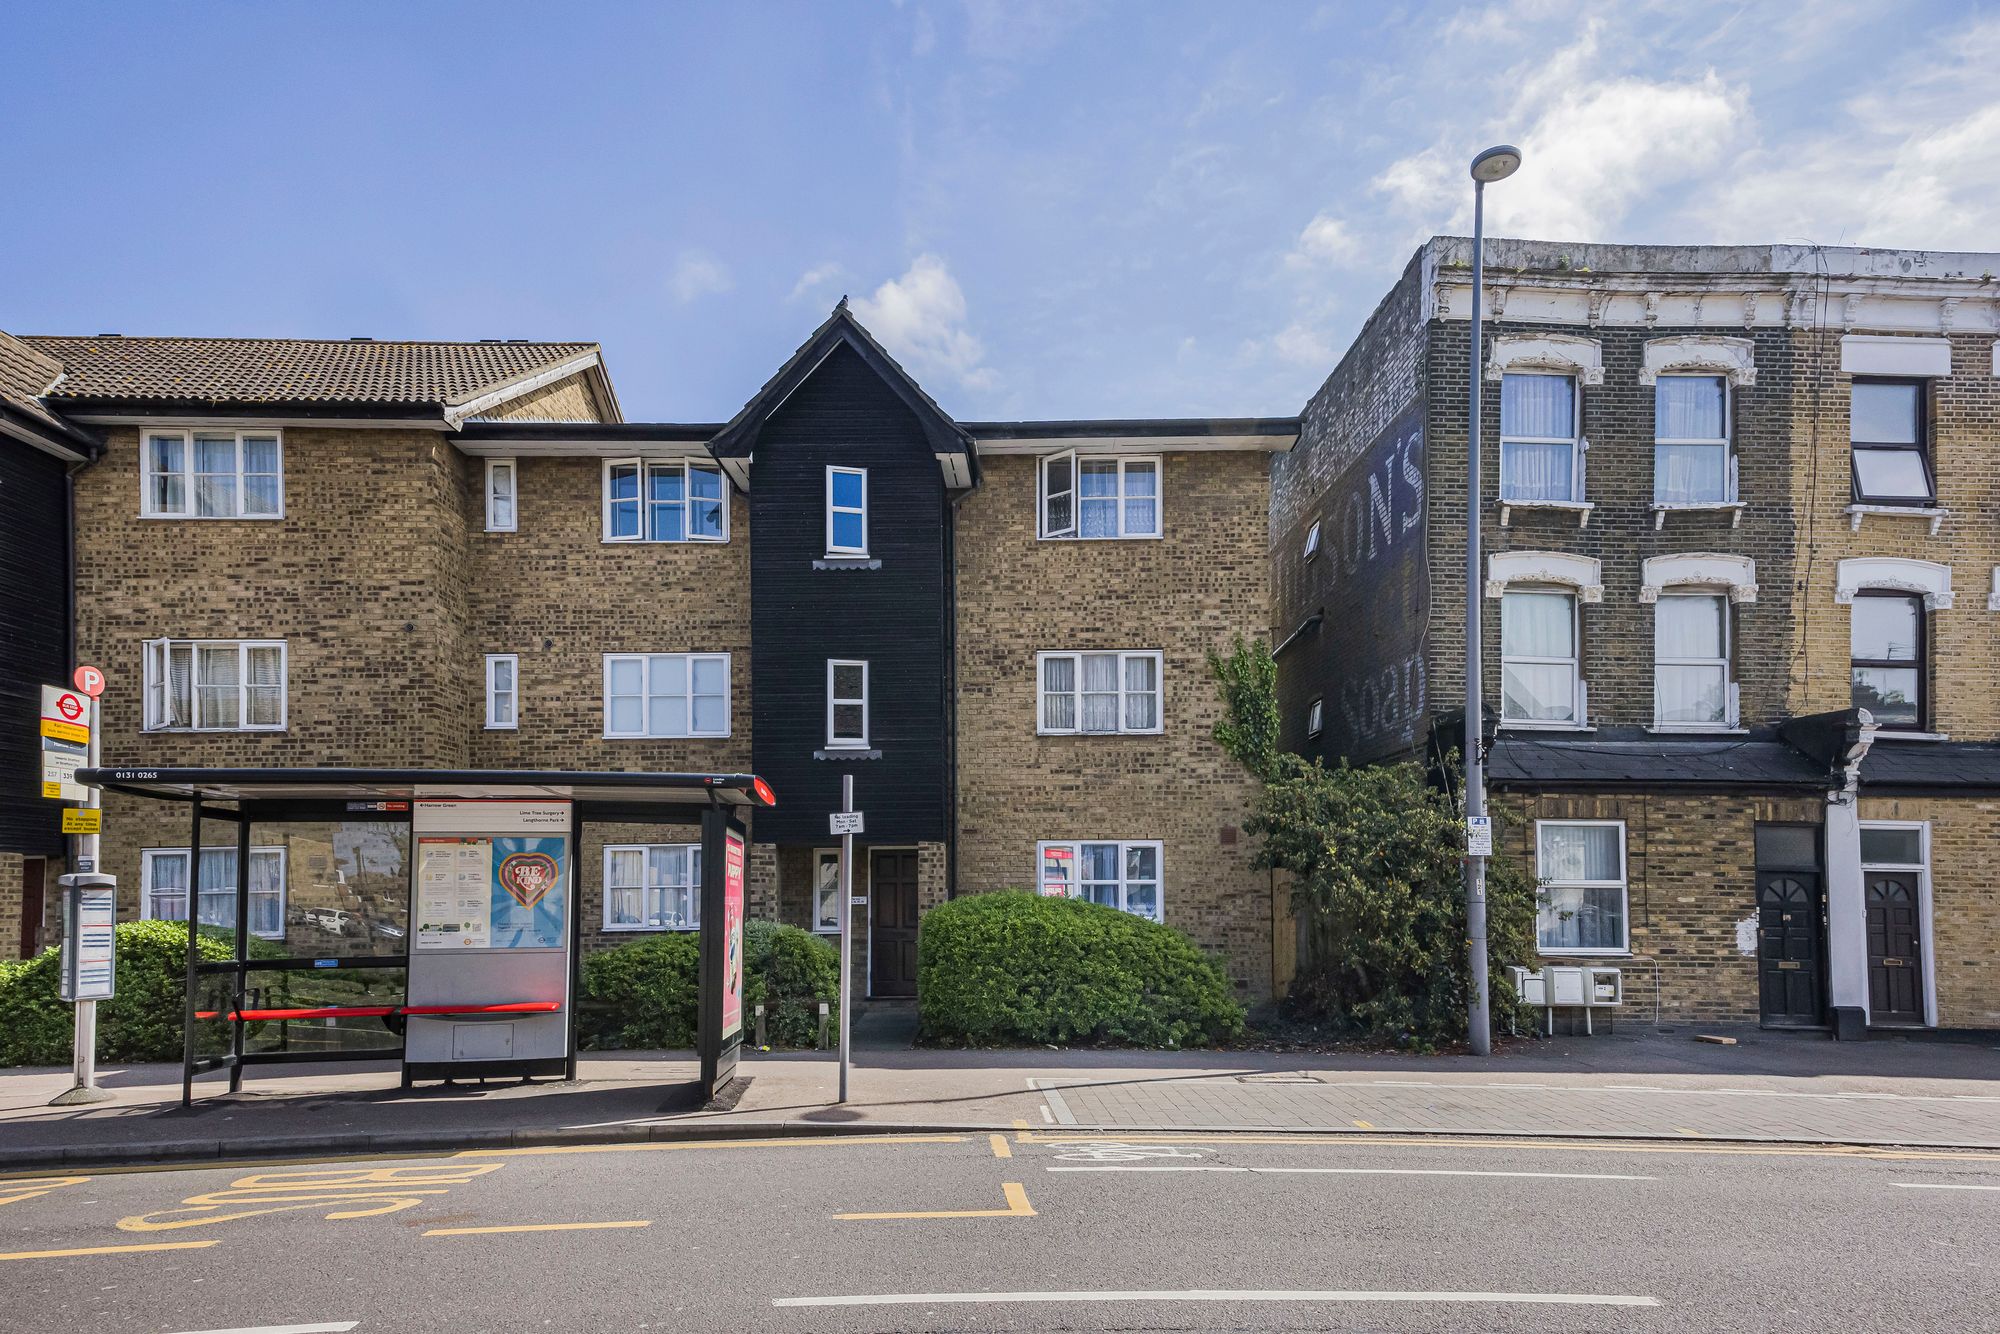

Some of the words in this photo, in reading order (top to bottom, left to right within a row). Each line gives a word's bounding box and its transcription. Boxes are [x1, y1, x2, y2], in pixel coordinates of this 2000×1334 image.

[84, 670, 100, 691] P
[515, 865, 541, 877] BE
[516, 876, 542, 890] KIND
[116, 1163, 506, 1232] BUS
